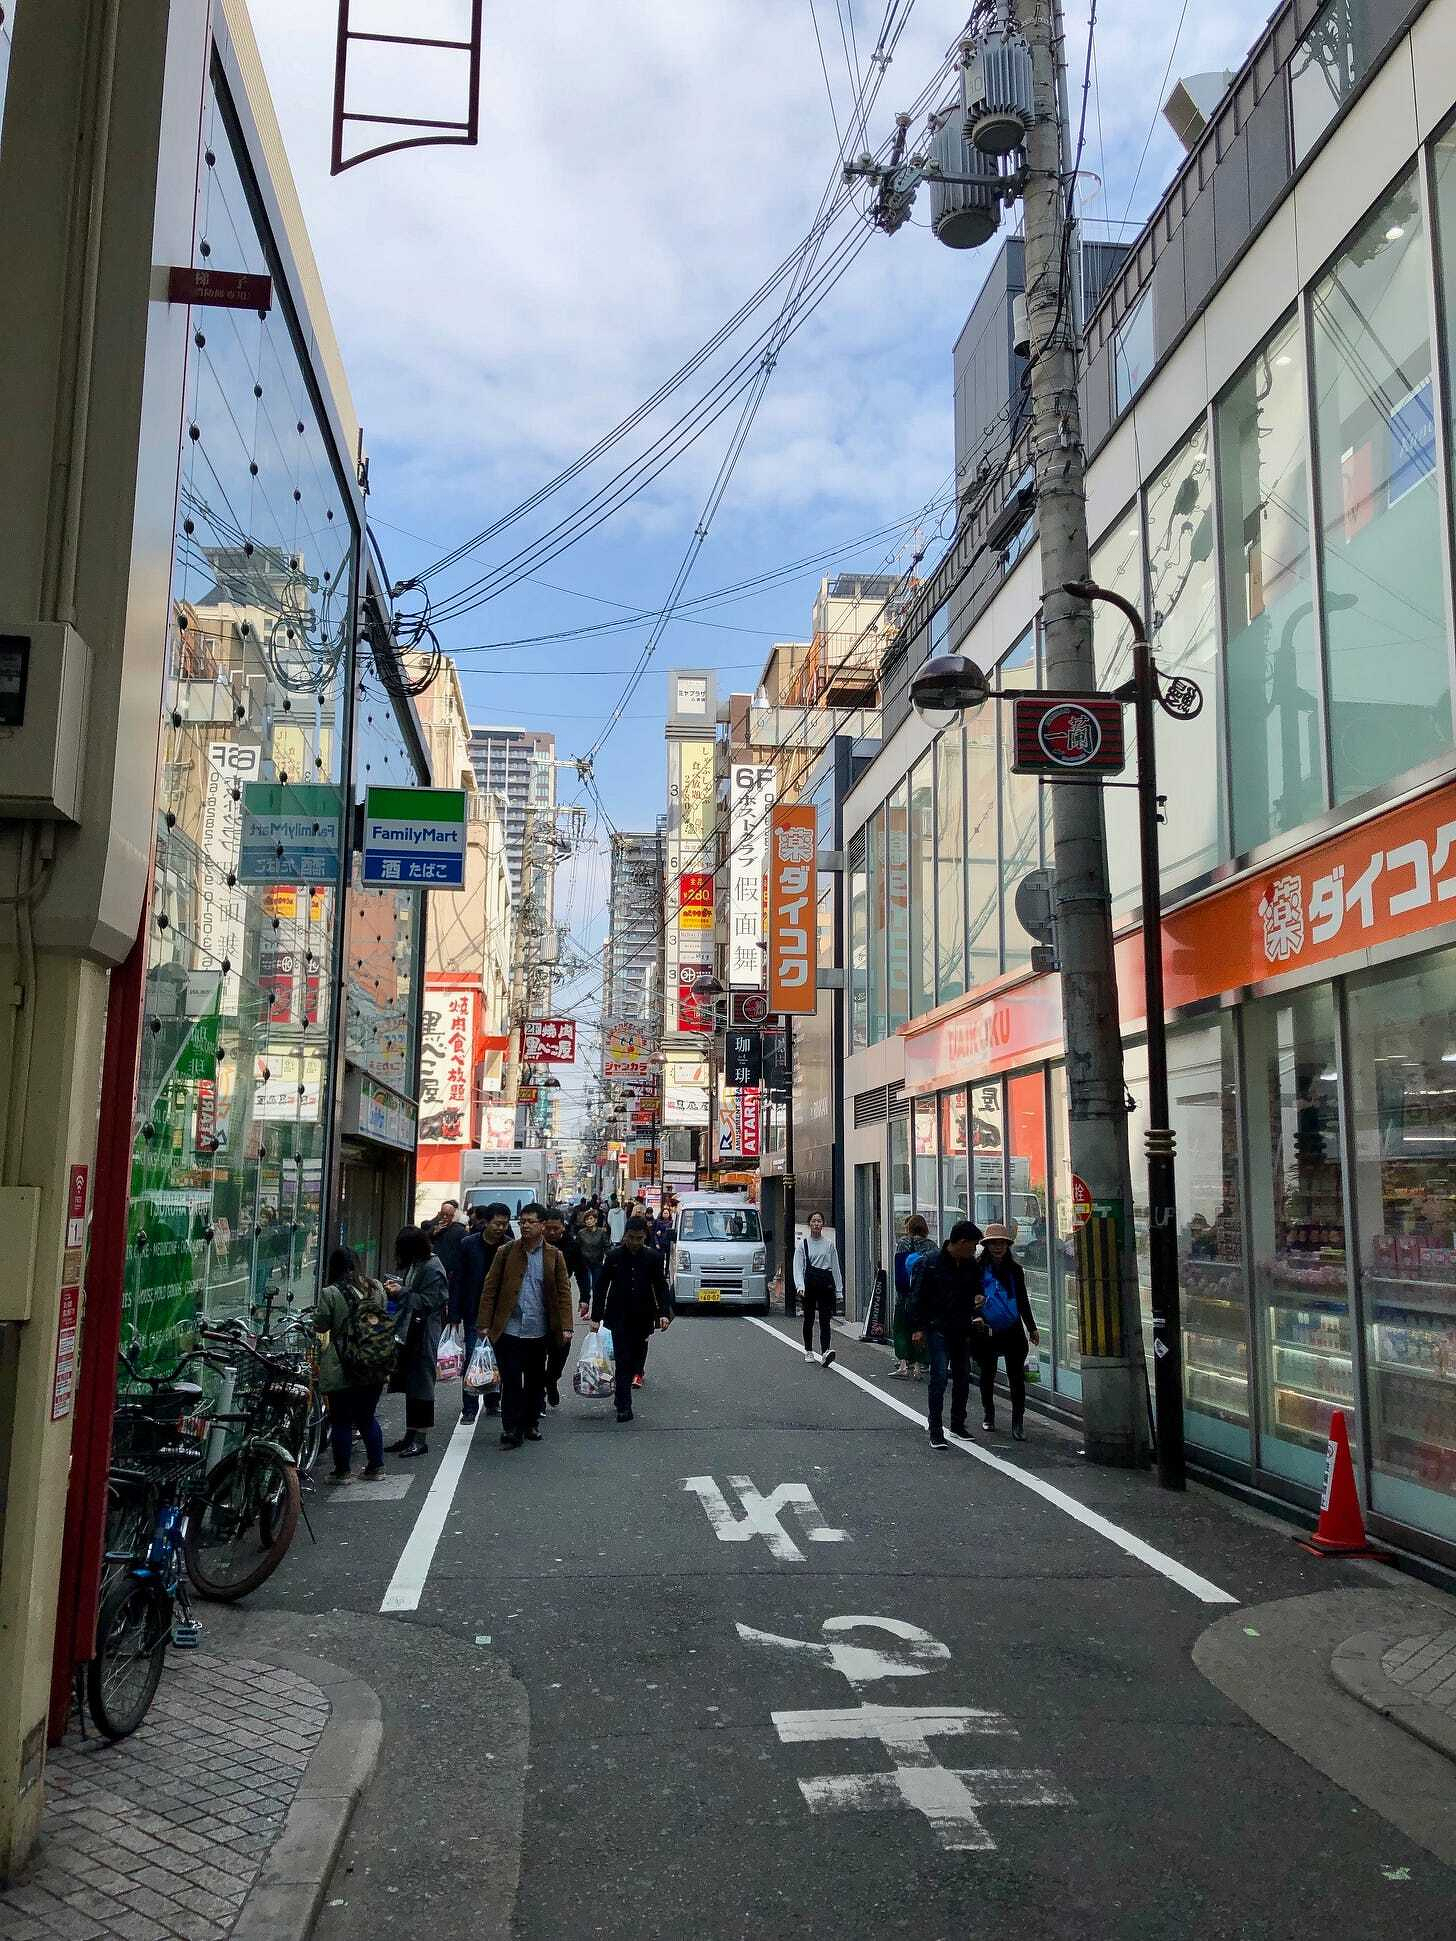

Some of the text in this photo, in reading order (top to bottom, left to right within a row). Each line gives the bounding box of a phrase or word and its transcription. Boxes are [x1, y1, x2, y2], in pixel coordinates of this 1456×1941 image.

[736, 767, 773, 789] 6F
[372, 826, 458, 844] FamilyMart
[381, 859, 448, 879] 酒 たばこ
[775, 821, 815, 988] 薬ダイコク
